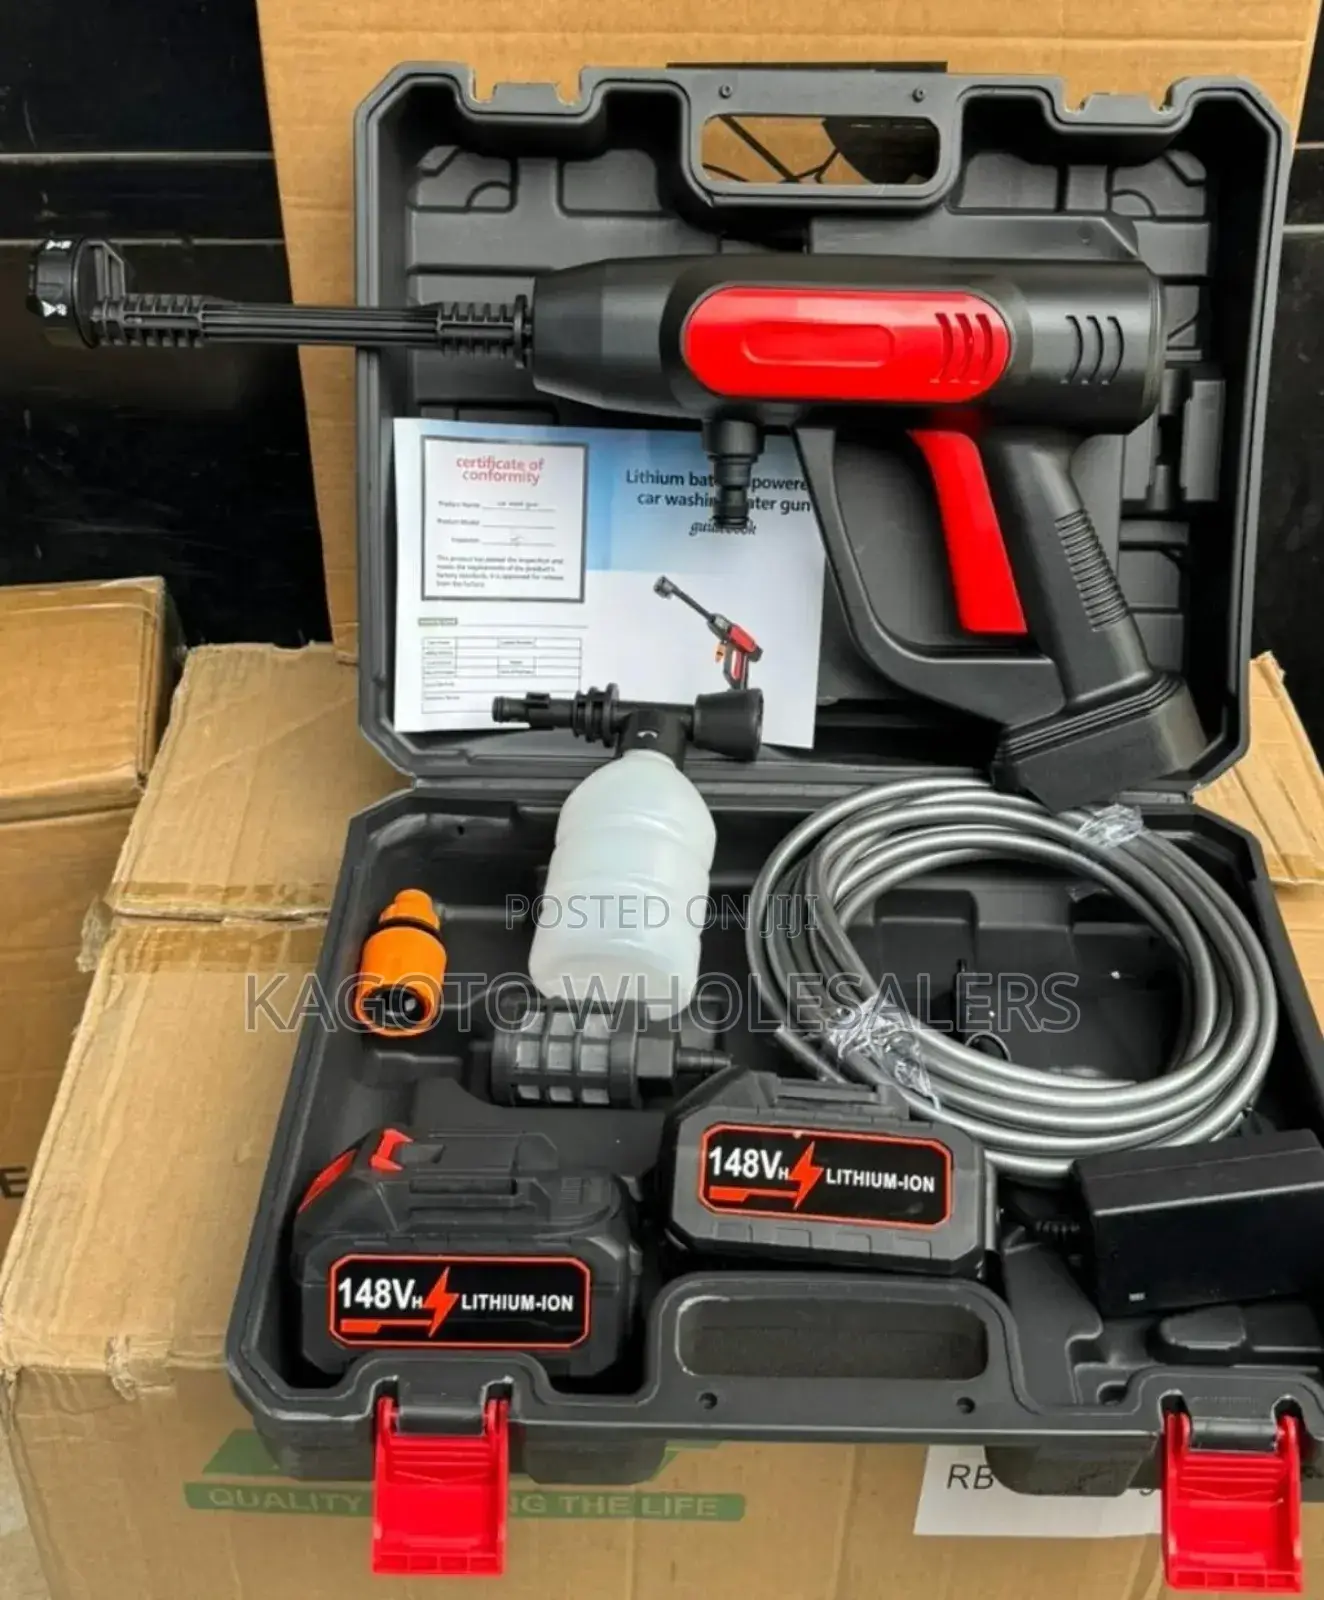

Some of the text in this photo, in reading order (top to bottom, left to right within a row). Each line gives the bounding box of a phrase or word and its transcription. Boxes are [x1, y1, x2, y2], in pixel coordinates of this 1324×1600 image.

[456, 455, 546, 471] certificate of
[462, 469, 540, 487] conformity
[626, 468, 685, 486] Lithium
[751, 477, 809, 493] powere
[637, 493, 660, 506] car
[779, 499, 811, 516] gun
[825, 1167, 936, 1194] LITHIUM-ION
[460, 1293, 575, 1312] LITHIUM-ION
[208, 1488, 363, 1513] QUALITY
[558, 1494, 633, 1515] THE
[641, 1496, 718, 1517] LIFE
